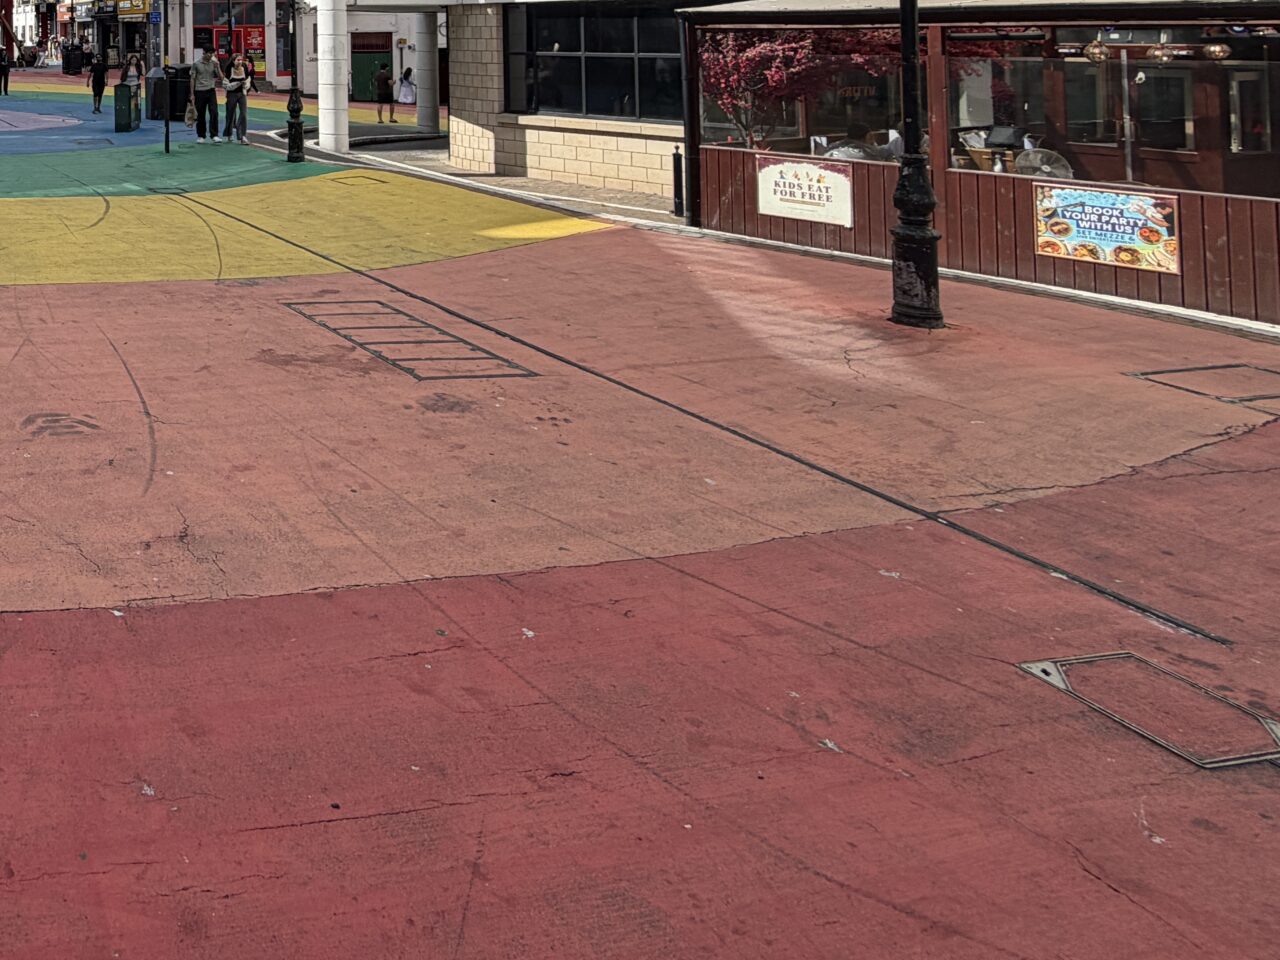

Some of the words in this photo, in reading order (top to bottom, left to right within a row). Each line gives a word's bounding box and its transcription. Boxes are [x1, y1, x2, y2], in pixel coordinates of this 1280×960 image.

[774, 180, 803, 191] KIDS
[808, 184, 831, 194] EAT
[773, 188, 796, 198] FOR
[801, 191, 833, 203] FREE
[1084, 206, 1122, 217] BOOK
[1064, 211, 1098, 222] YOUR
[1101, 216, 1144, 227] PARTY
[1078, 220, 1112, 231] WITH
[1095, 231, 1125, 241] MEZZE
